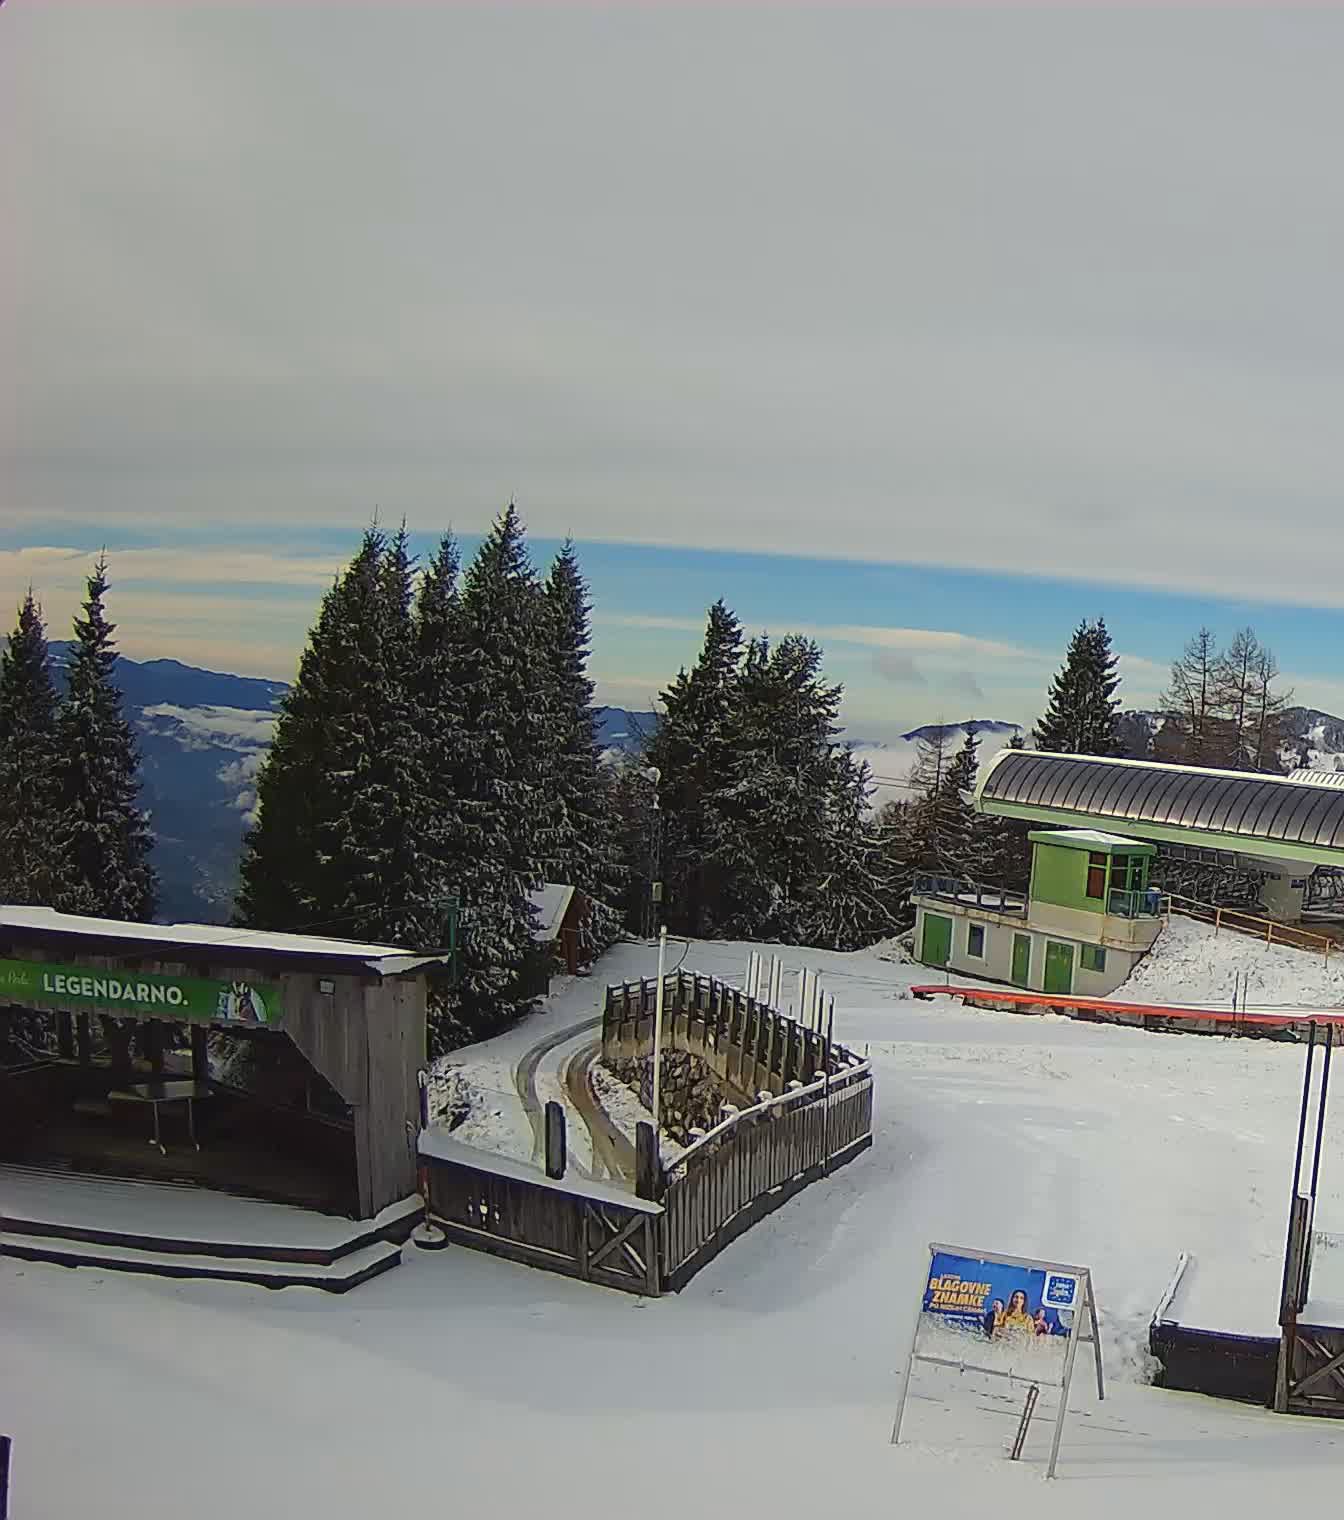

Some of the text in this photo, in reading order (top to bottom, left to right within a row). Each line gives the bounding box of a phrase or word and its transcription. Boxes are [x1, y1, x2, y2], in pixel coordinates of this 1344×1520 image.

[42, 973, 189, 1006] LEGENDARNO.
[929, 1277, 992, 1296] BLAGOVNE
[932, 1290, 985, 1307] ZNAMKE
